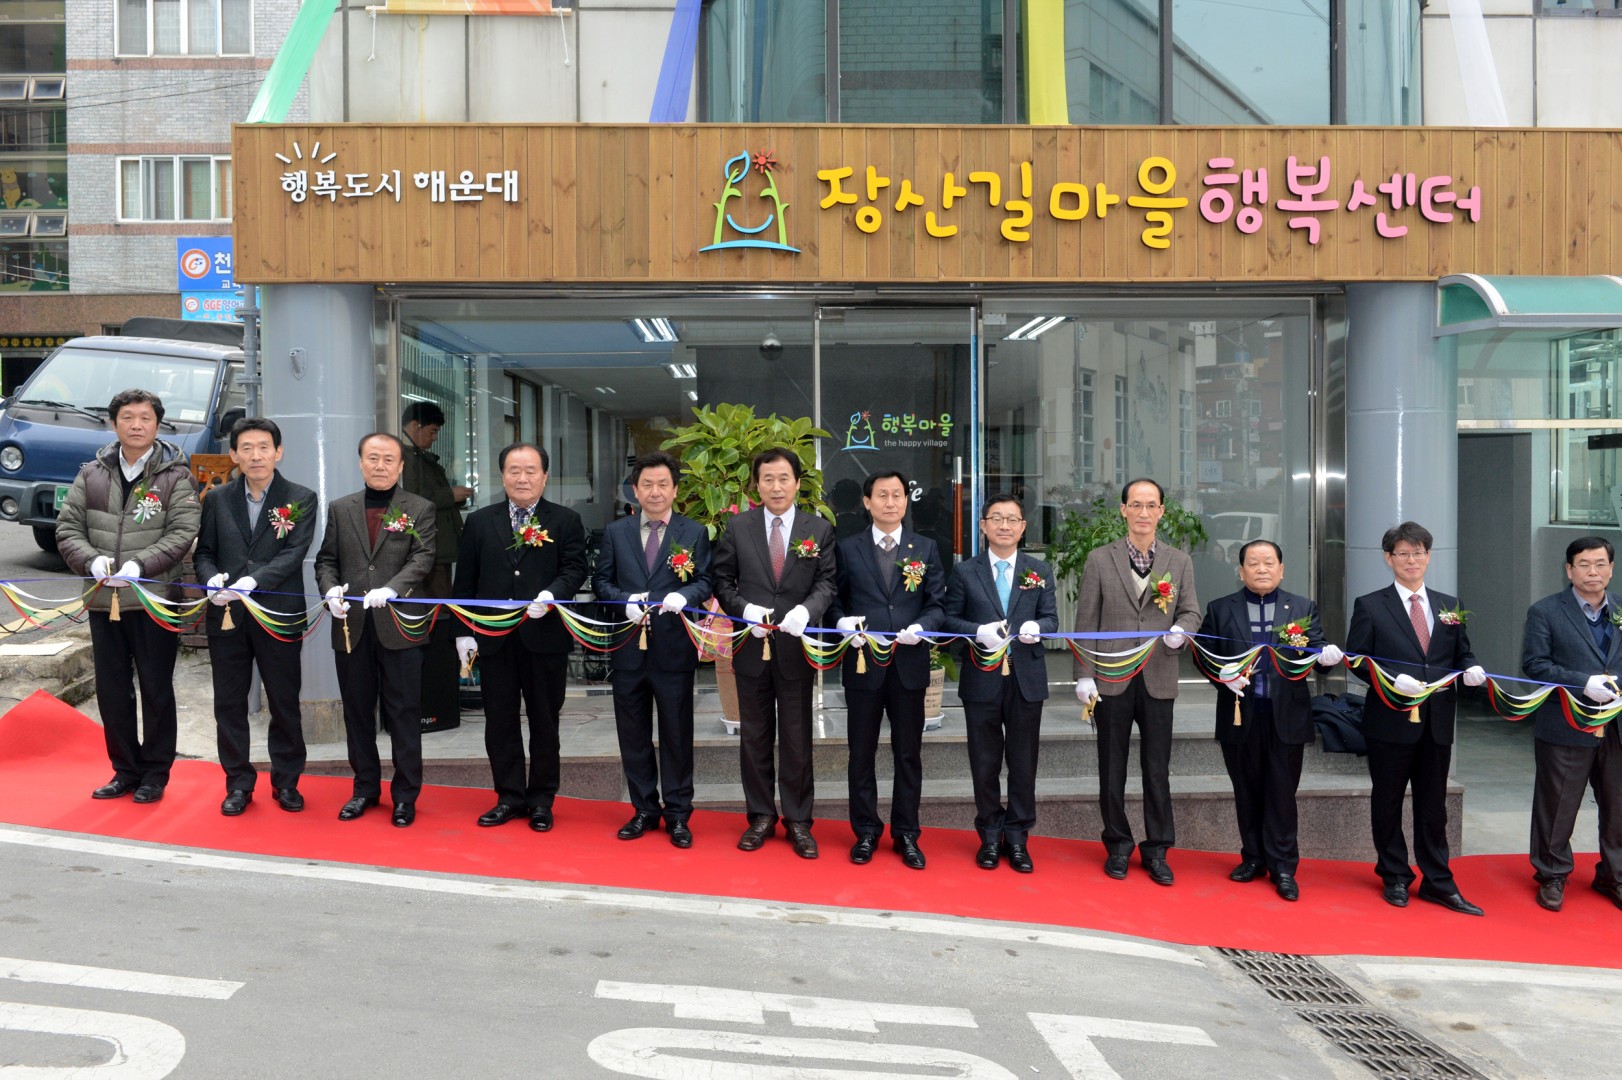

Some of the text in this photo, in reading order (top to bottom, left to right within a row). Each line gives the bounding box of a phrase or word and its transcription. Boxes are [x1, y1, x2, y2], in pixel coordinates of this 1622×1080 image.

[280, 169, 519, 203] 행복도시 해운대
[881, 413, 954, 437] 행복마을
[884, 439, 948, 448] the happy village
